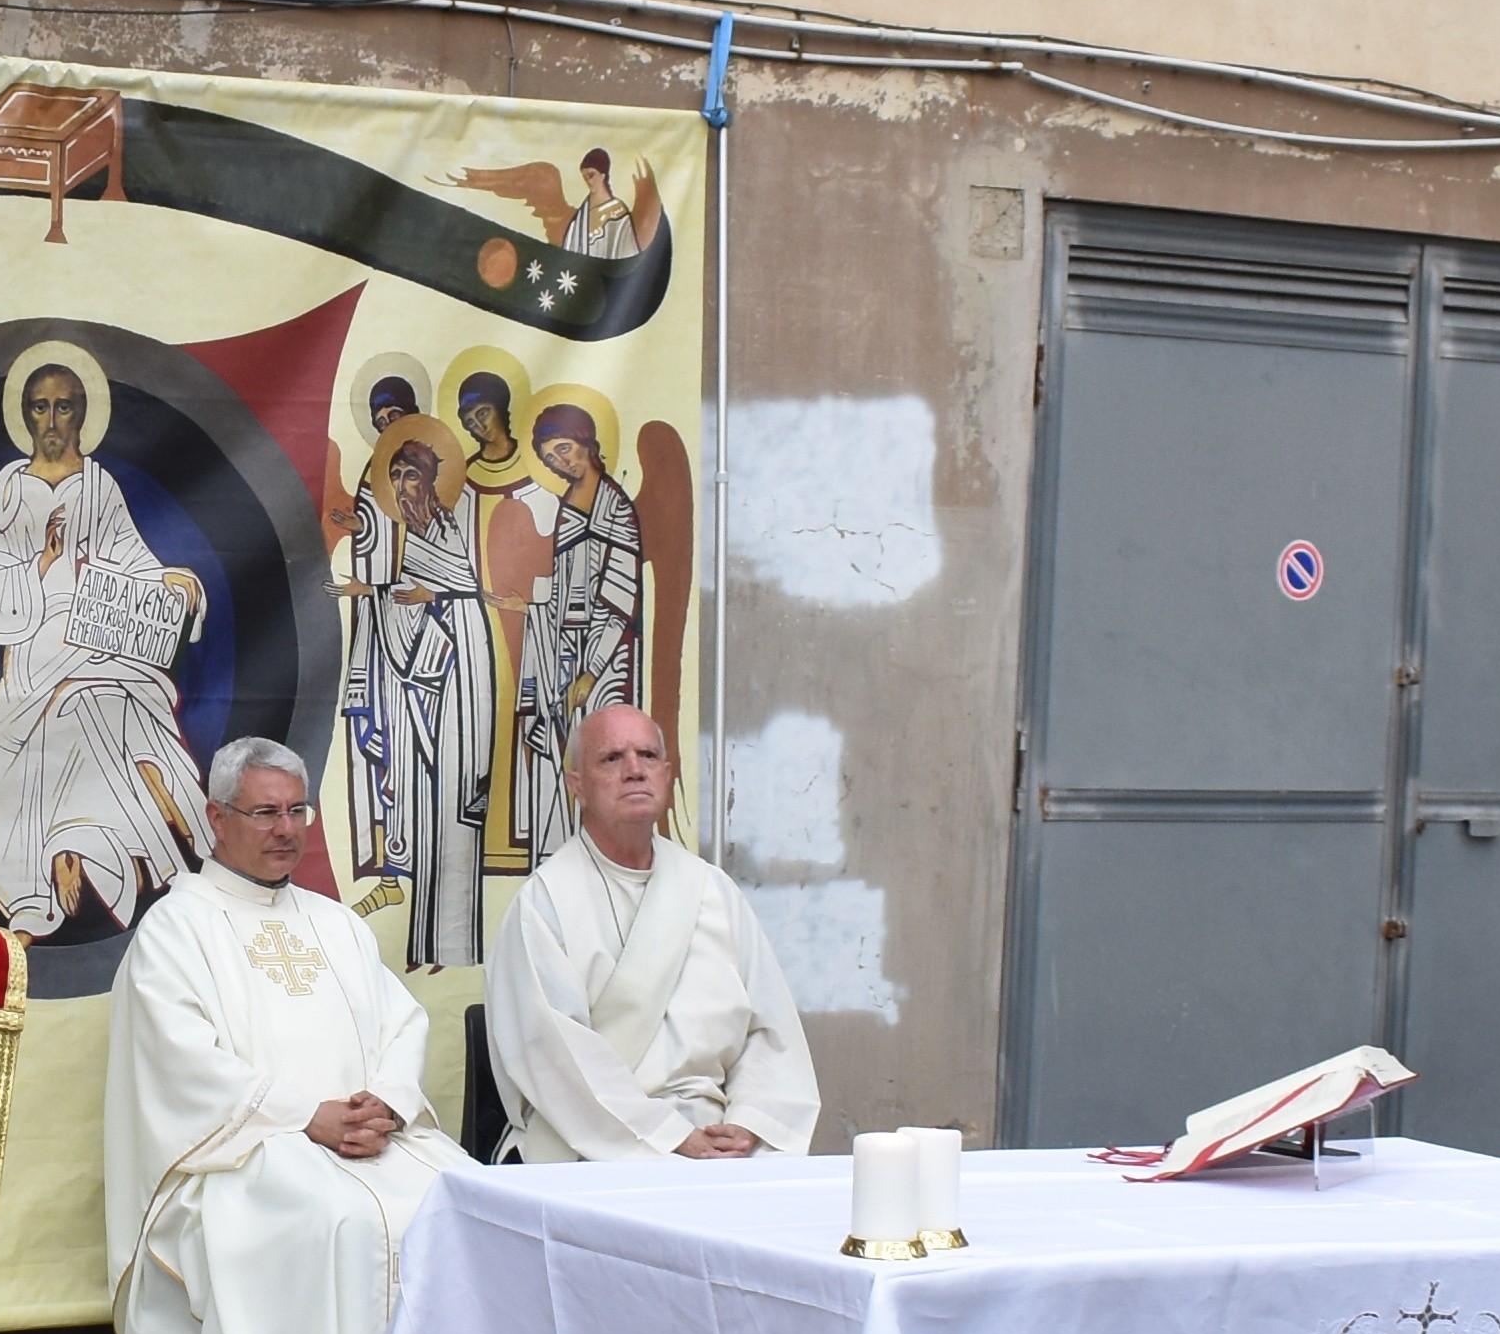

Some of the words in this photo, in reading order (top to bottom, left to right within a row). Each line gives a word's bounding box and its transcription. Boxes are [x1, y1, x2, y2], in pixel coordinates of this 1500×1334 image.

[79, 568, 118, 603] AMAD
[116, 579, 129, 609] A
[134, 581, 185, 626] VENGO
[75, 595, 127, 629] VUESTROS
[69, 617, 123, 653] ENEMIGOS
[123, 617, 178, 667] PRONTO
